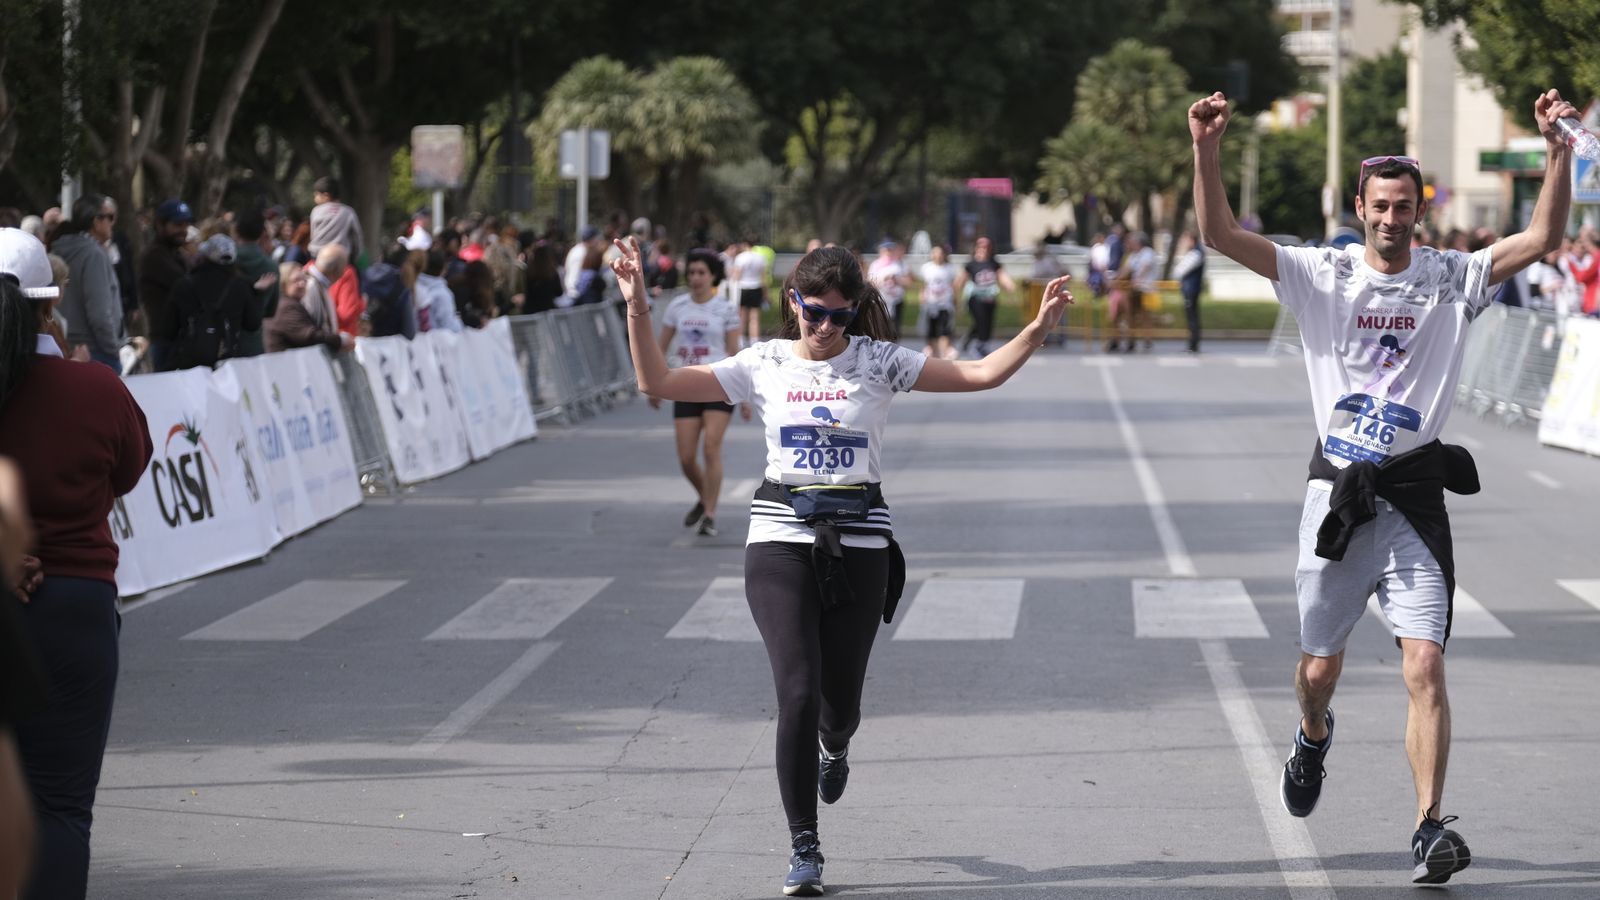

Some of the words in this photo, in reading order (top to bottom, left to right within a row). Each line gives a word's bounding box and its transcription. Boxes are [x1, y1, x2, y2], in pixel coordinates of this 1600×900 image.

[1361, 306, 1393, 314] CARRERA
[1394, 306, 1404, 315] DE
[1357, 315, 1416, 330] MUJER
[786, 389, 848, 402] MUJER
[1347, 400, 1368, 408] MUJER
[1352, 415, 1396, 445] 146
[1347, 434, 1363, 443] JUAN
[1364, 439, 1391, 452] IGNACIO
[793, 447, 855, 469] 2030
[151, 451, 214, 528] CASI
